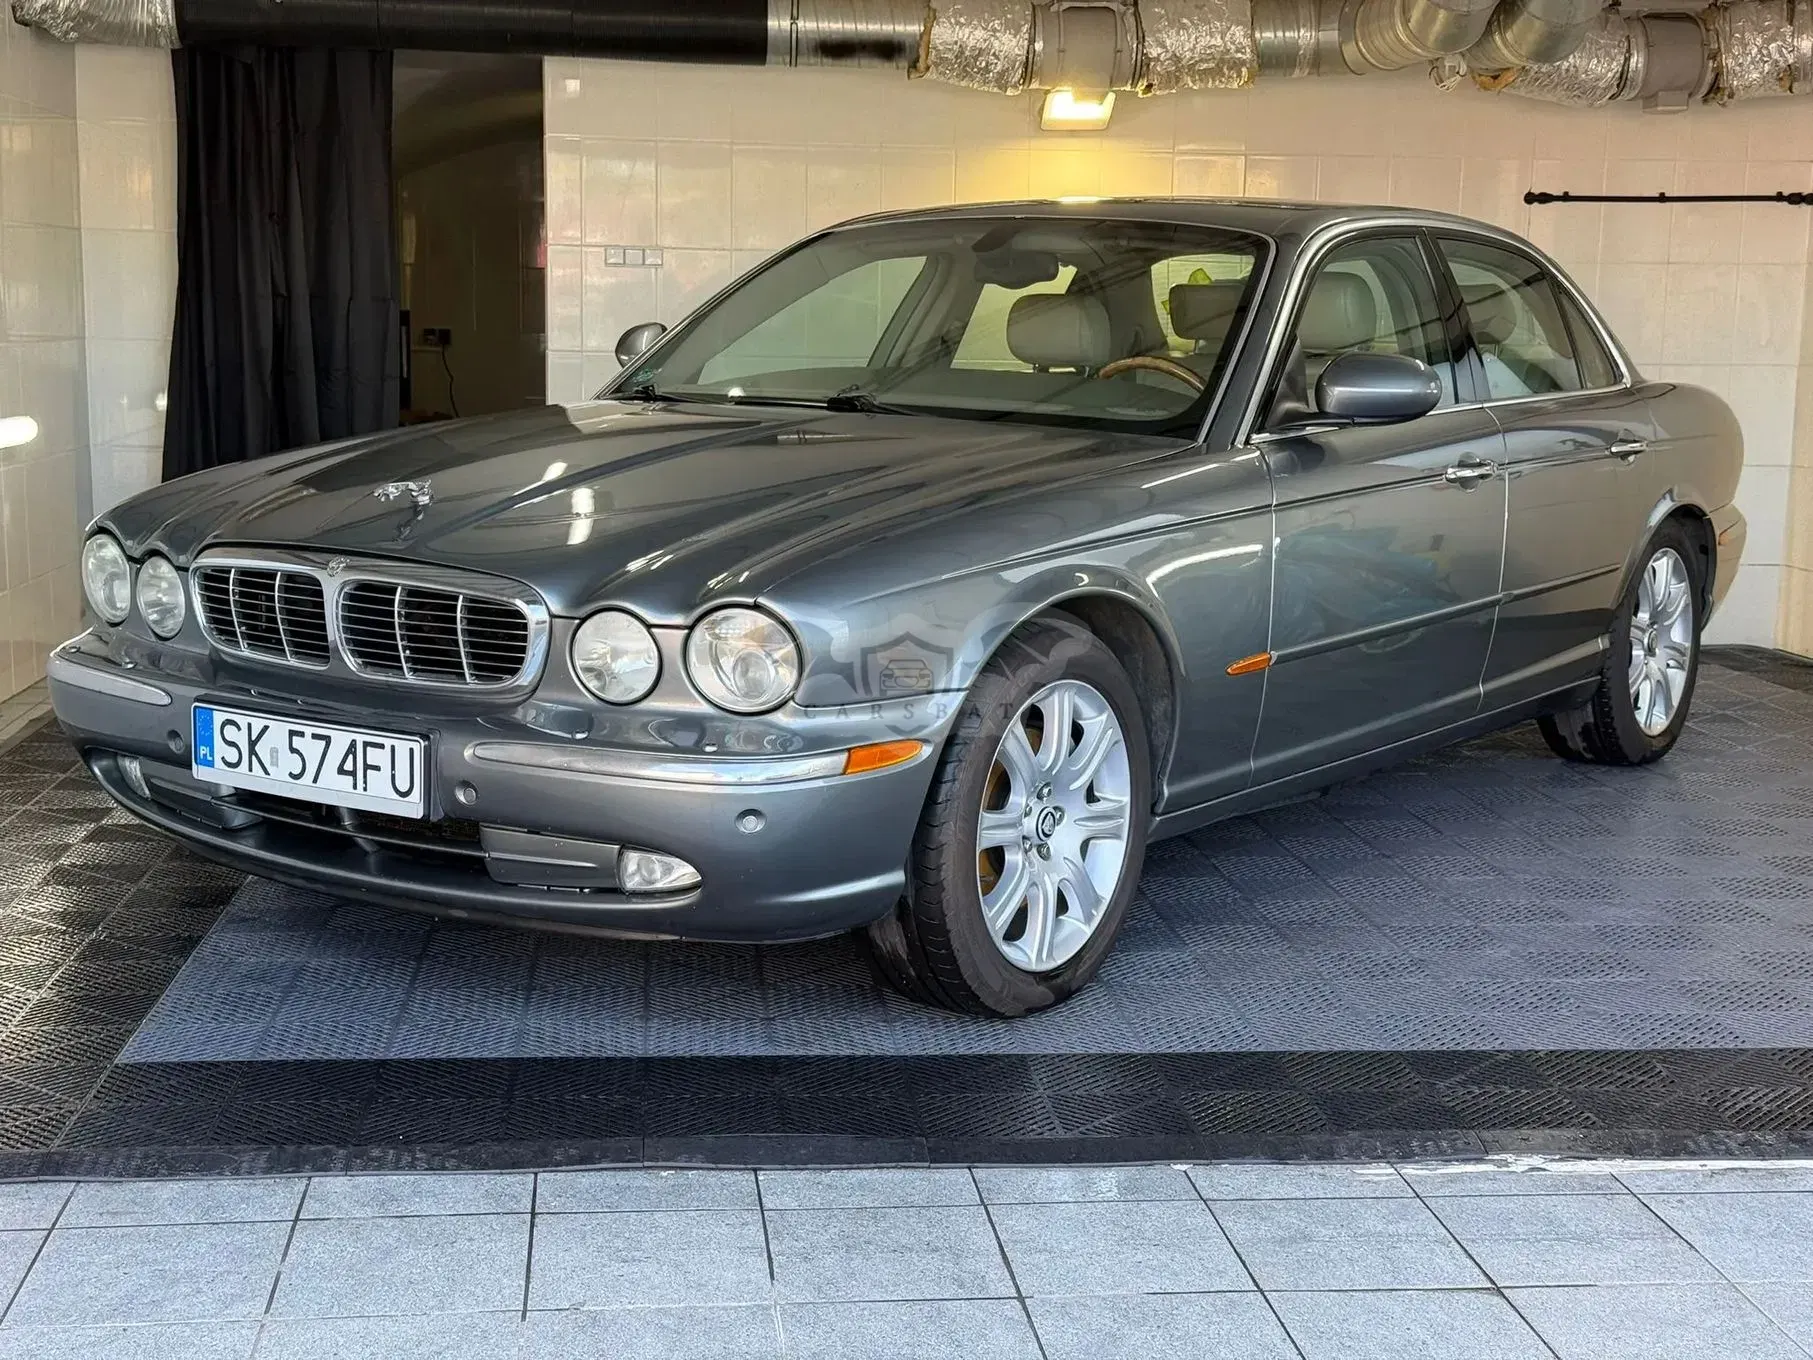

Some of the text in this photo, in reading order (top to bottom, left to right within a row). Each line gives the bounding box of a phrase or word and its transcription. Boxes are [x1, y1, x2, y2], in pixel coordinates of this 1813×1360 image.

[200, 746, 213, 761] PL
[219, 718, 415, 799] SK 574FU
